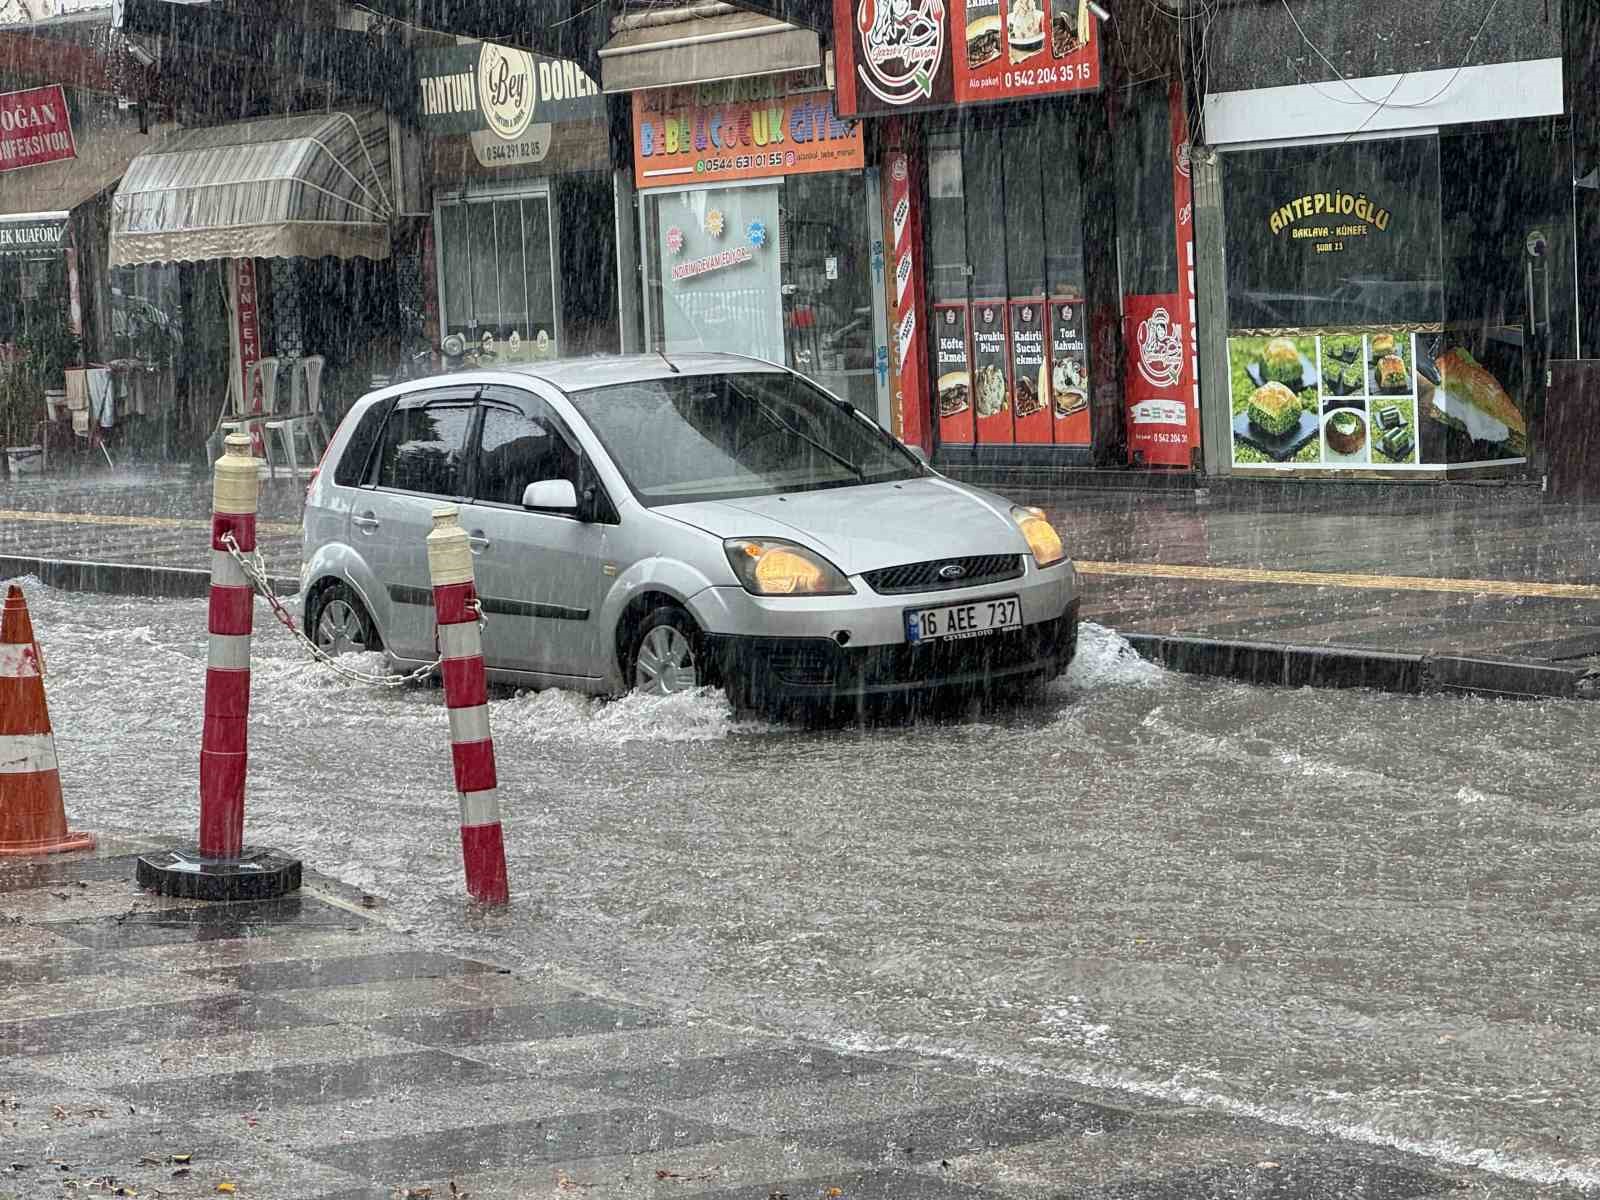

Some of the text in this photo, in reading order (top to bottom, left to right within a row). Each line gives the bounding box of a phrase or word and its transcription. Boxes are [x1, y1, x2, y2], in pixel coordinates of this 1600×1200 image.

[489, 57, 524, 108] Bey
[1005, 72, 1012, 88] 0
[1014, 70, 1035, 87] 542
[1037, 67, 1057, 84] 204
[1060, 65, 1074, 81] 35
[1076, 63, 1090, 79] 15
[706, 158, 732, 171] 0544
[735, 156, 753, 169] 631
[769, 151, 782, 166] 55
[1269, 189, 1390, 235] ANTEPLİOĞLU
[1292, 227, 1329, 239] BAKLAVA
[1336, 224, 1368, 236] KÜNEFE
[1060, 327, 1076, 338] Tost
[980, 342, 1000, 353] Pilav
[1016, 342, 1042, 353] Sucuk
[938, 351, 967, 363] Ekmek
[1016, 355, 1042, 365] ekmek
[920, 612, 937, 636] 16
[947, 606, 977, 632] AEE
[987, 600, 1016, 626] 737
